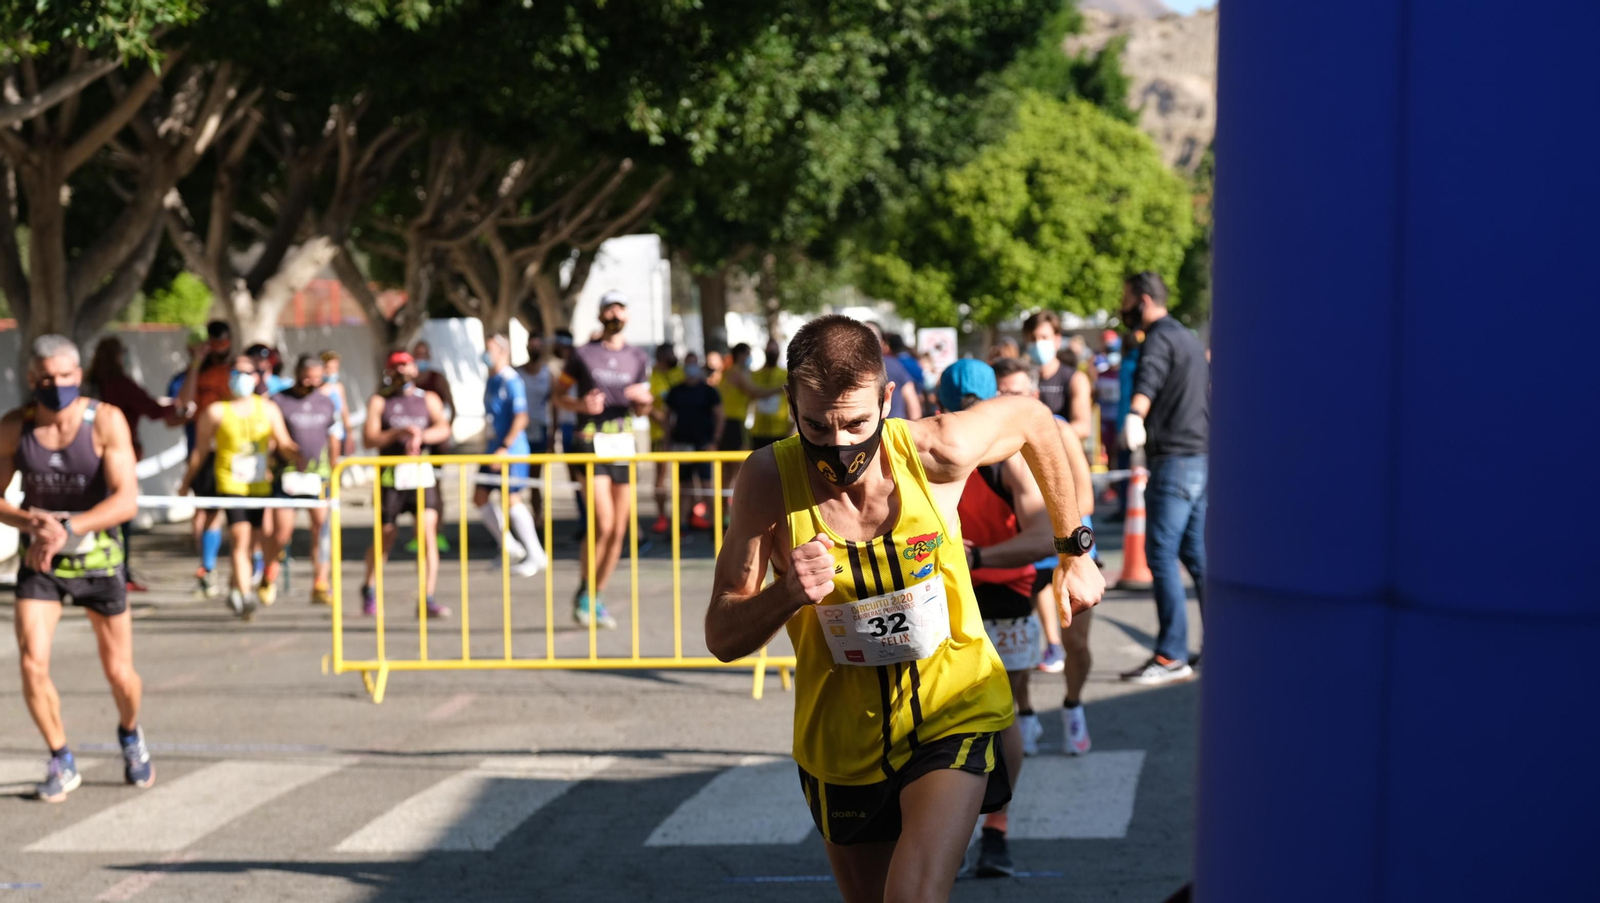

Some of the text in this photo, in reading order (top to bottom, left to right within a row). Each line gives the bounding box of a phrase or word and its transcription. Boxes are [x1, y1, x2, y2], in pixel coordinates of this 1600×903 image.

[851, 599, 889, 616] CIRCUITO
[852, 608, 883, 621] CARRERAS
[867, 612, 910, 637] 32
[881, 633, 911, 647] FELIX
